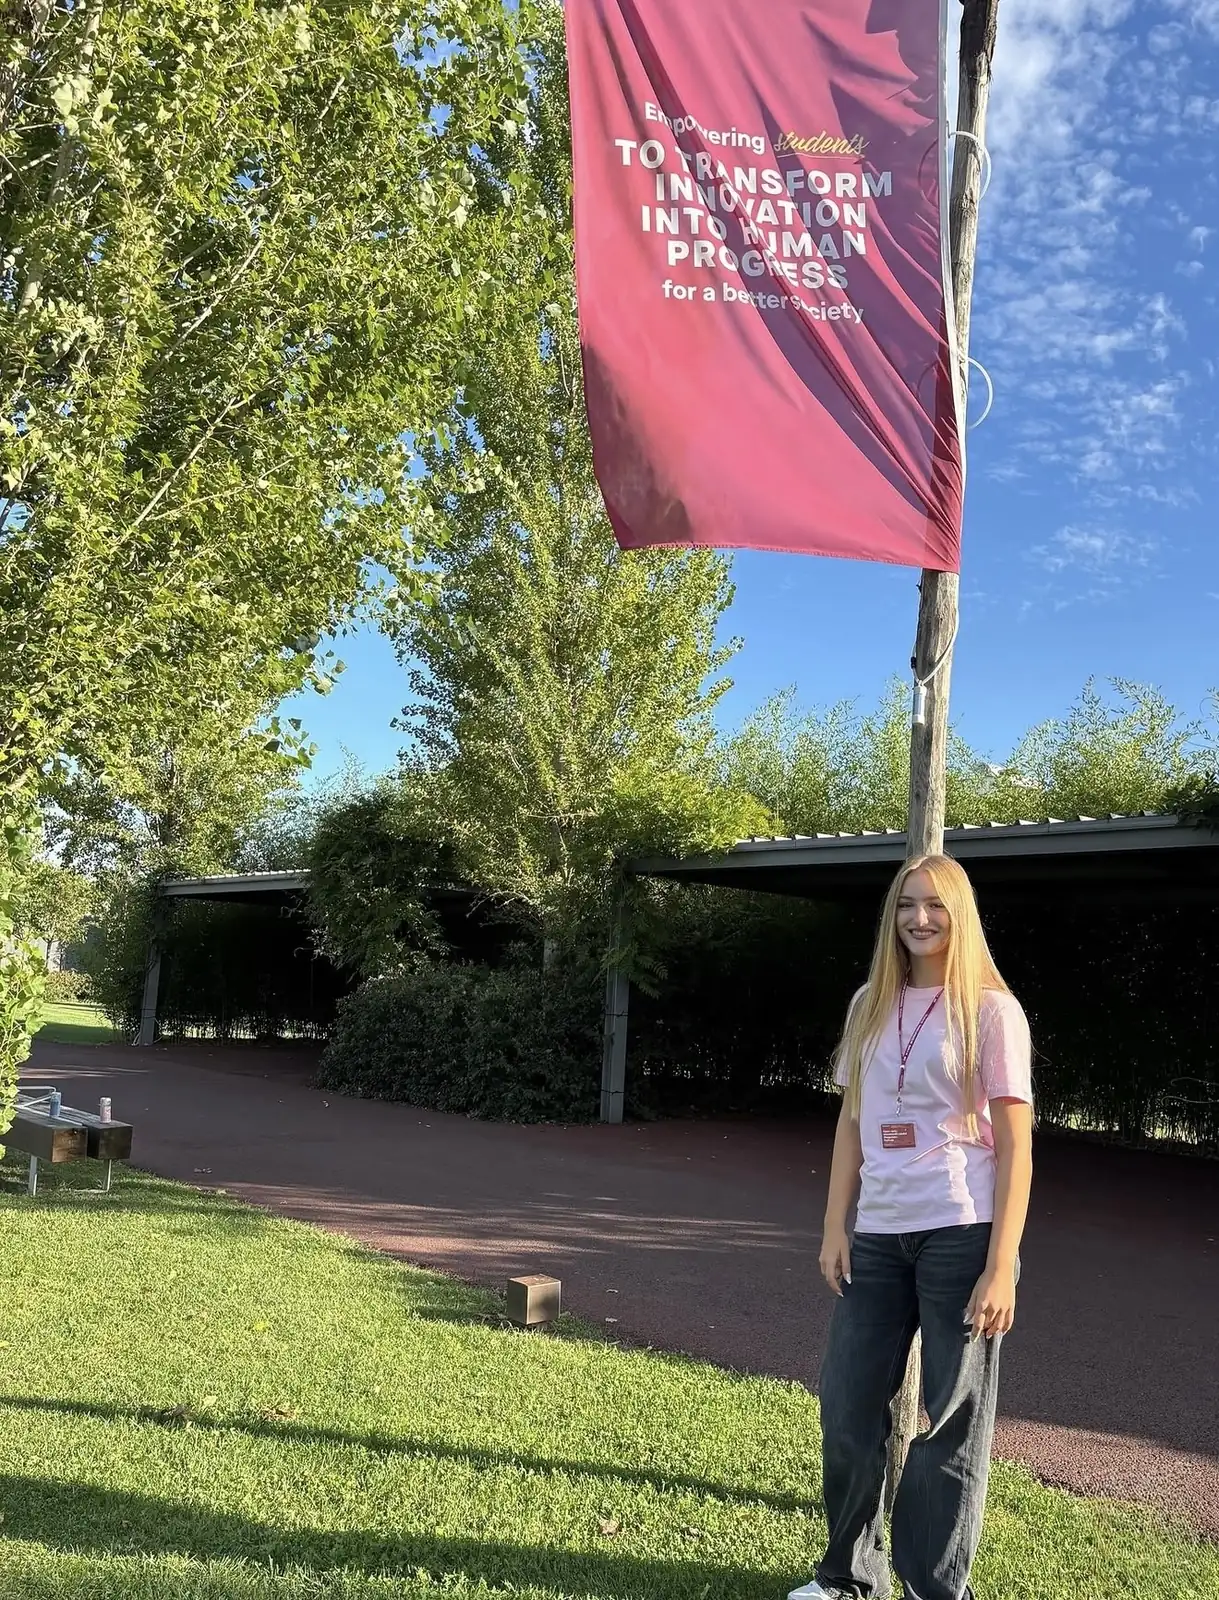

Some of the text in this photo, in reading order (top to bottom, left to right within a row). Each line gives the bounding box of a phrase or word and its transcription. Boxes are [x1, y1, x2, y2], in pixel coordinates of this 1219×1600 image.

[614, 138, 893, 198] TO TRANSFORM
[773, 131, 870, 156] students
[655, 172, 867, 228] INNOVATION
[641, 205, 867, 260] INTO HUMAN
[666, 239, 849, 289] PROGRESS
[661, 279, 697, 301] for
[702, 286, 716, 302] a
[722, 282, 788, 310] better
